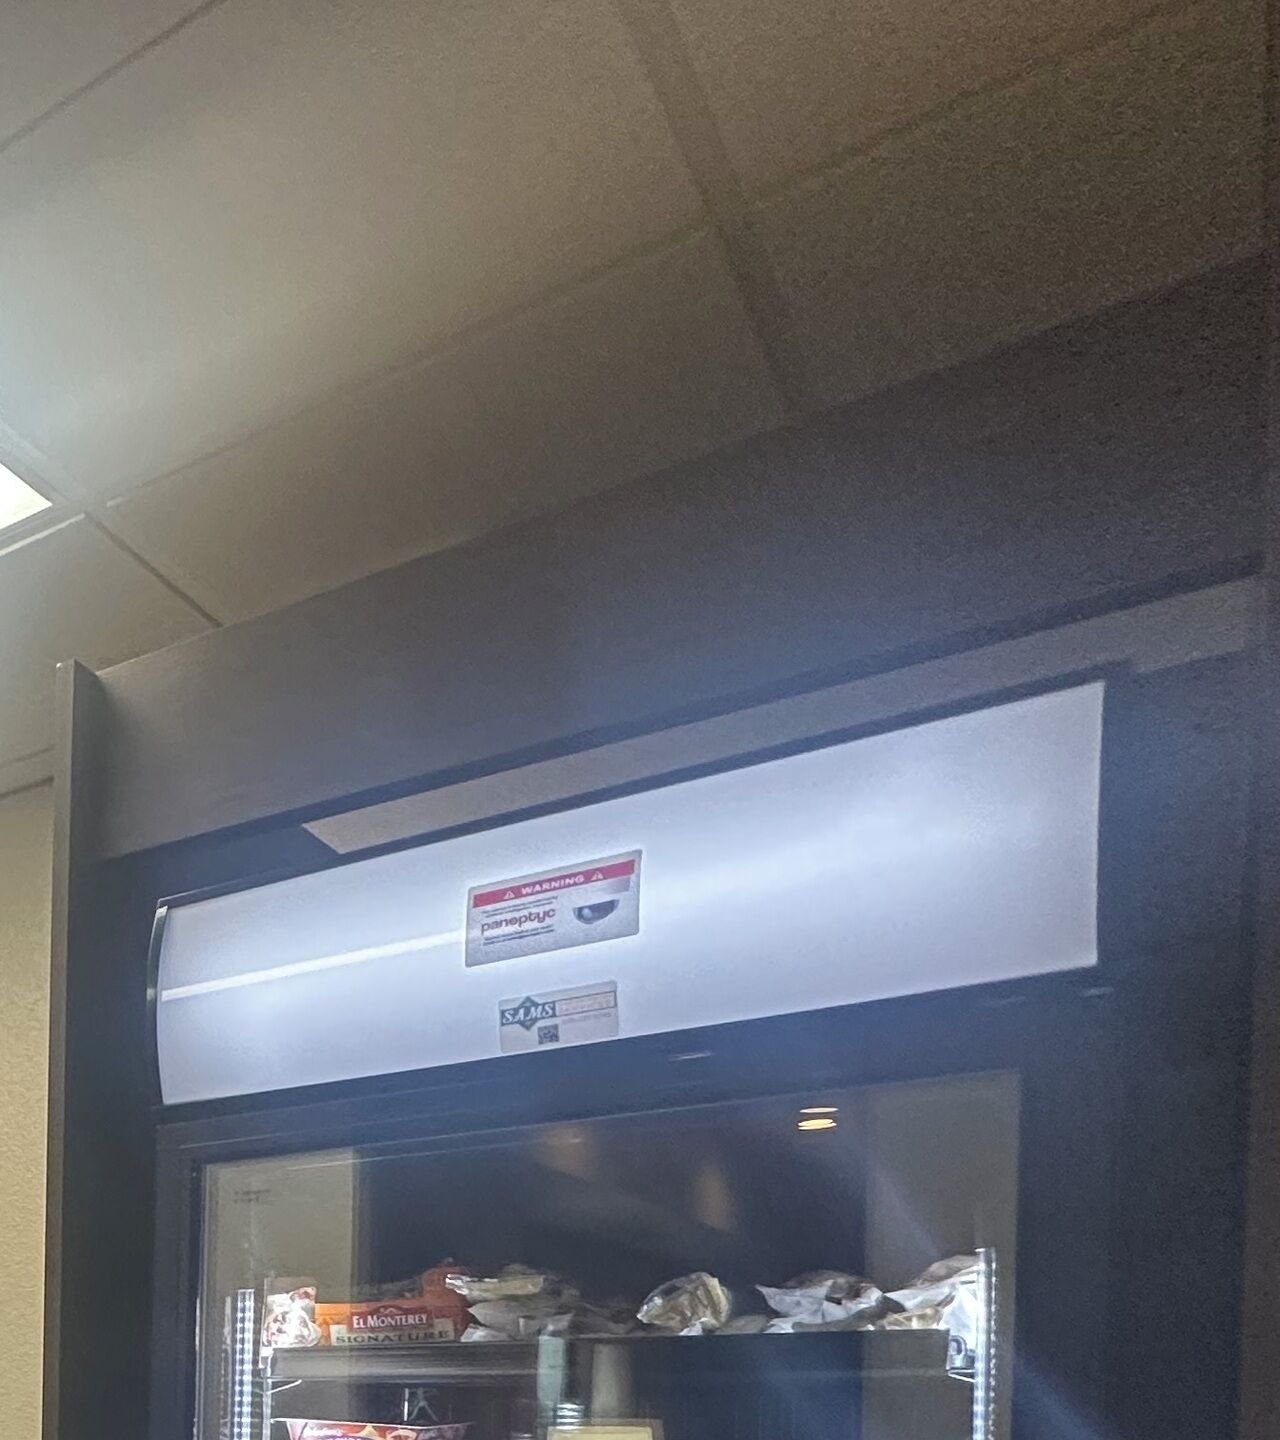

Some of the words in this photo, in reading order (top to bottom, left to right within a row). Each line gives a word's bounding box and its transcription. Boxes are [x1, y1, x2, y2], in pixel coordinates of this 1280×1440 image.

[521, 874, 585, 895] WARNING
[481, 908, 556, 936] panoptyc
[352, 1315, 366, 1329] EL
[366, 1313, 428, 1329] MONTEREY
[335, 1328, 450, 1344] SIGNATURE
